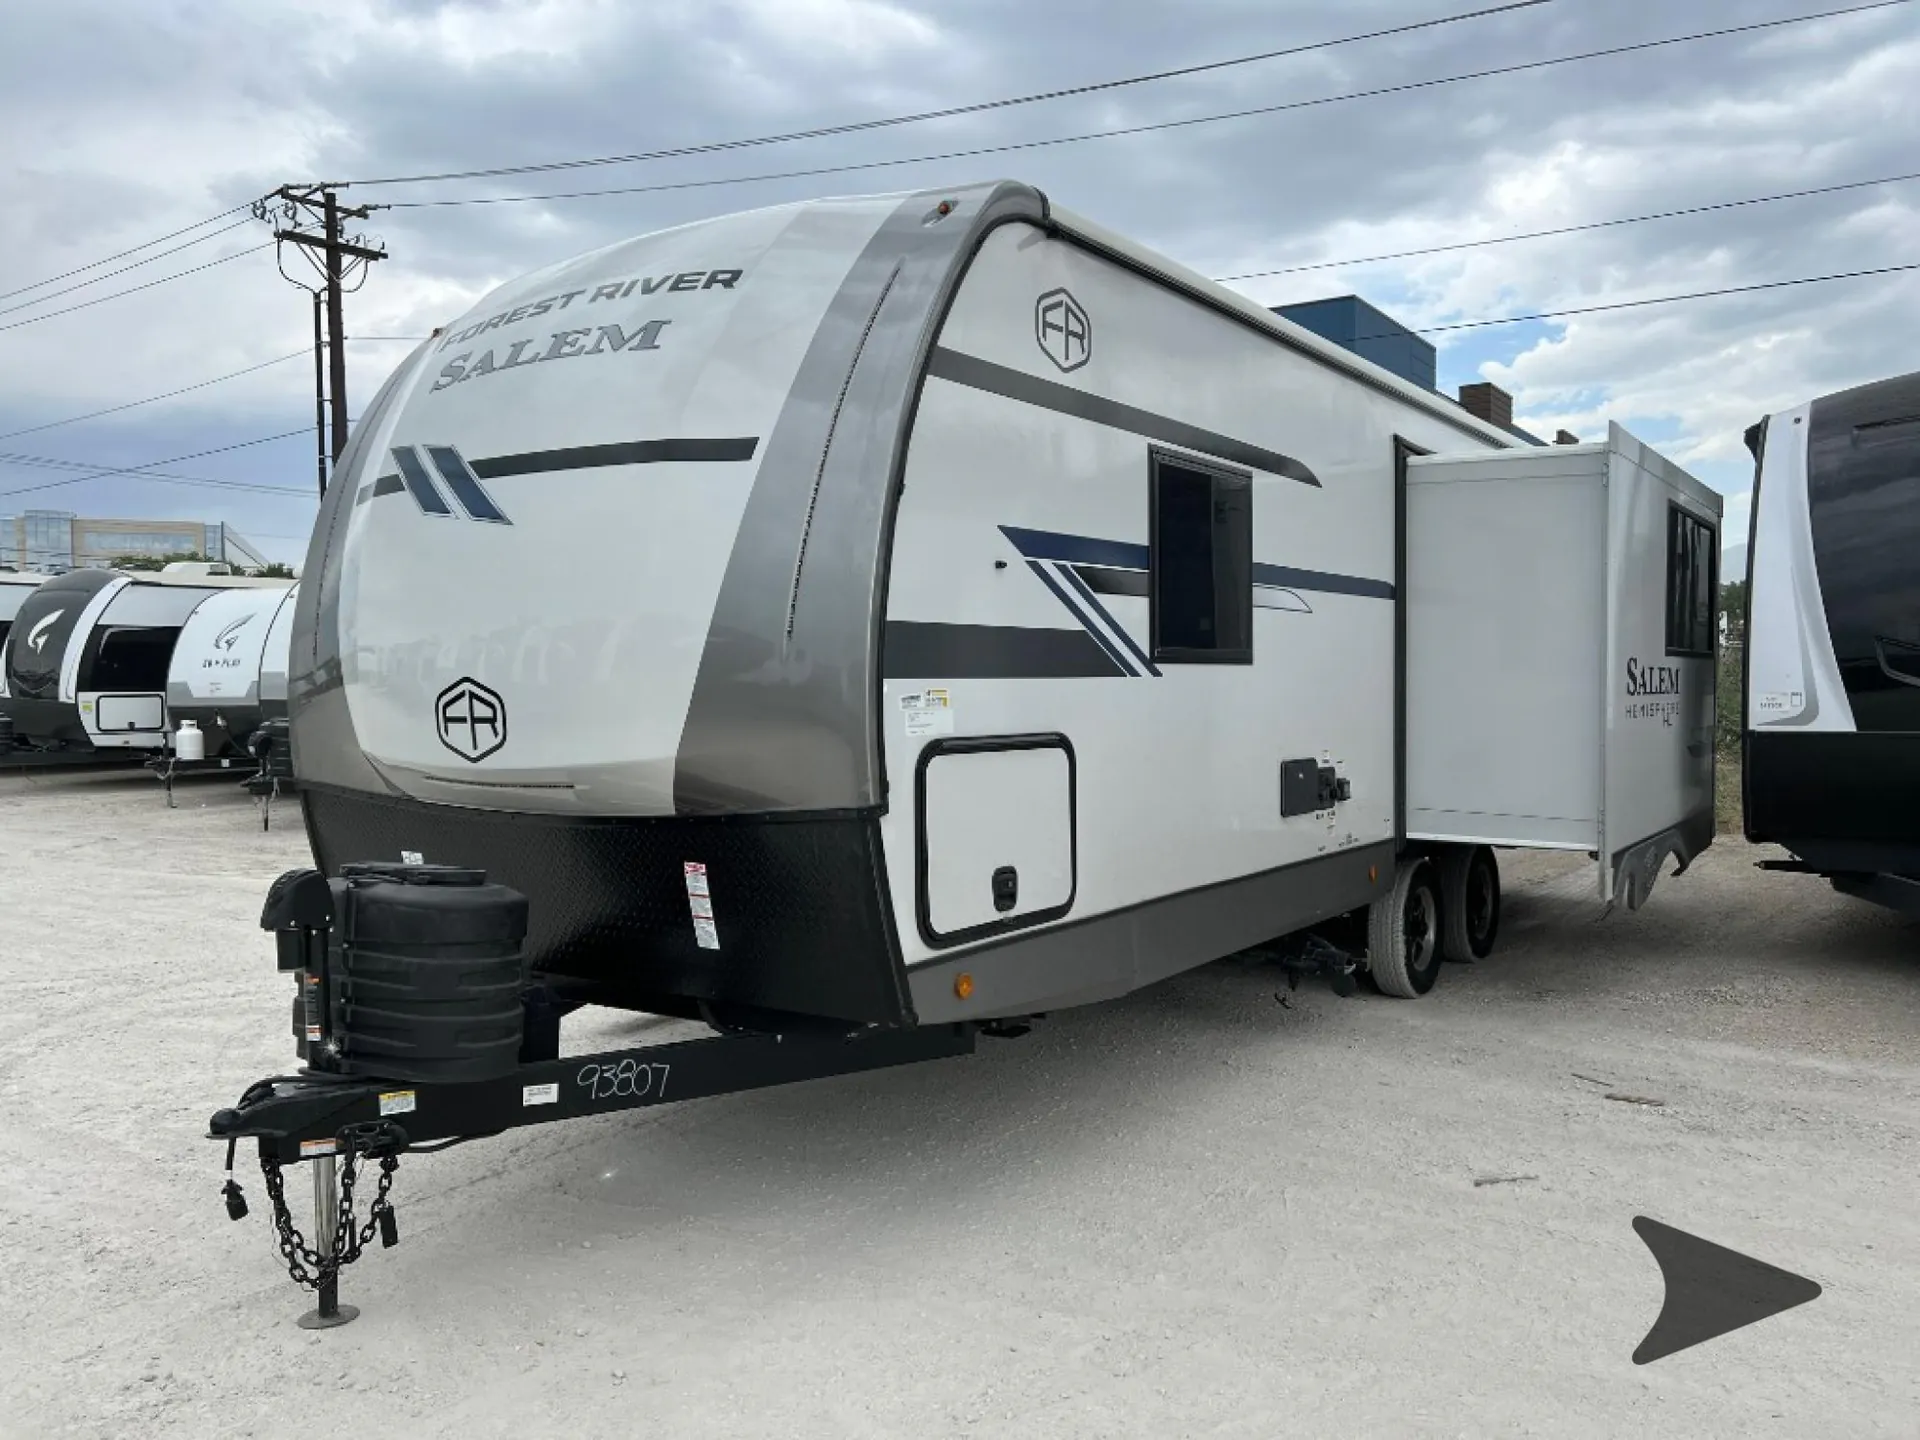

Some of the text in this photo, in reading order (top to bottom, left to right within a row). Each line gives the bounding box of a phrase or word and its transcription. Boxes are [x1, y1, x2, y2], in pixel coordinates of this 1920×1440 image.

[437, 269, 744, 353] FOREST RIVER
[429, 319, 672, 394] SALEM
[577, 1059, 670, 1100] 93807
